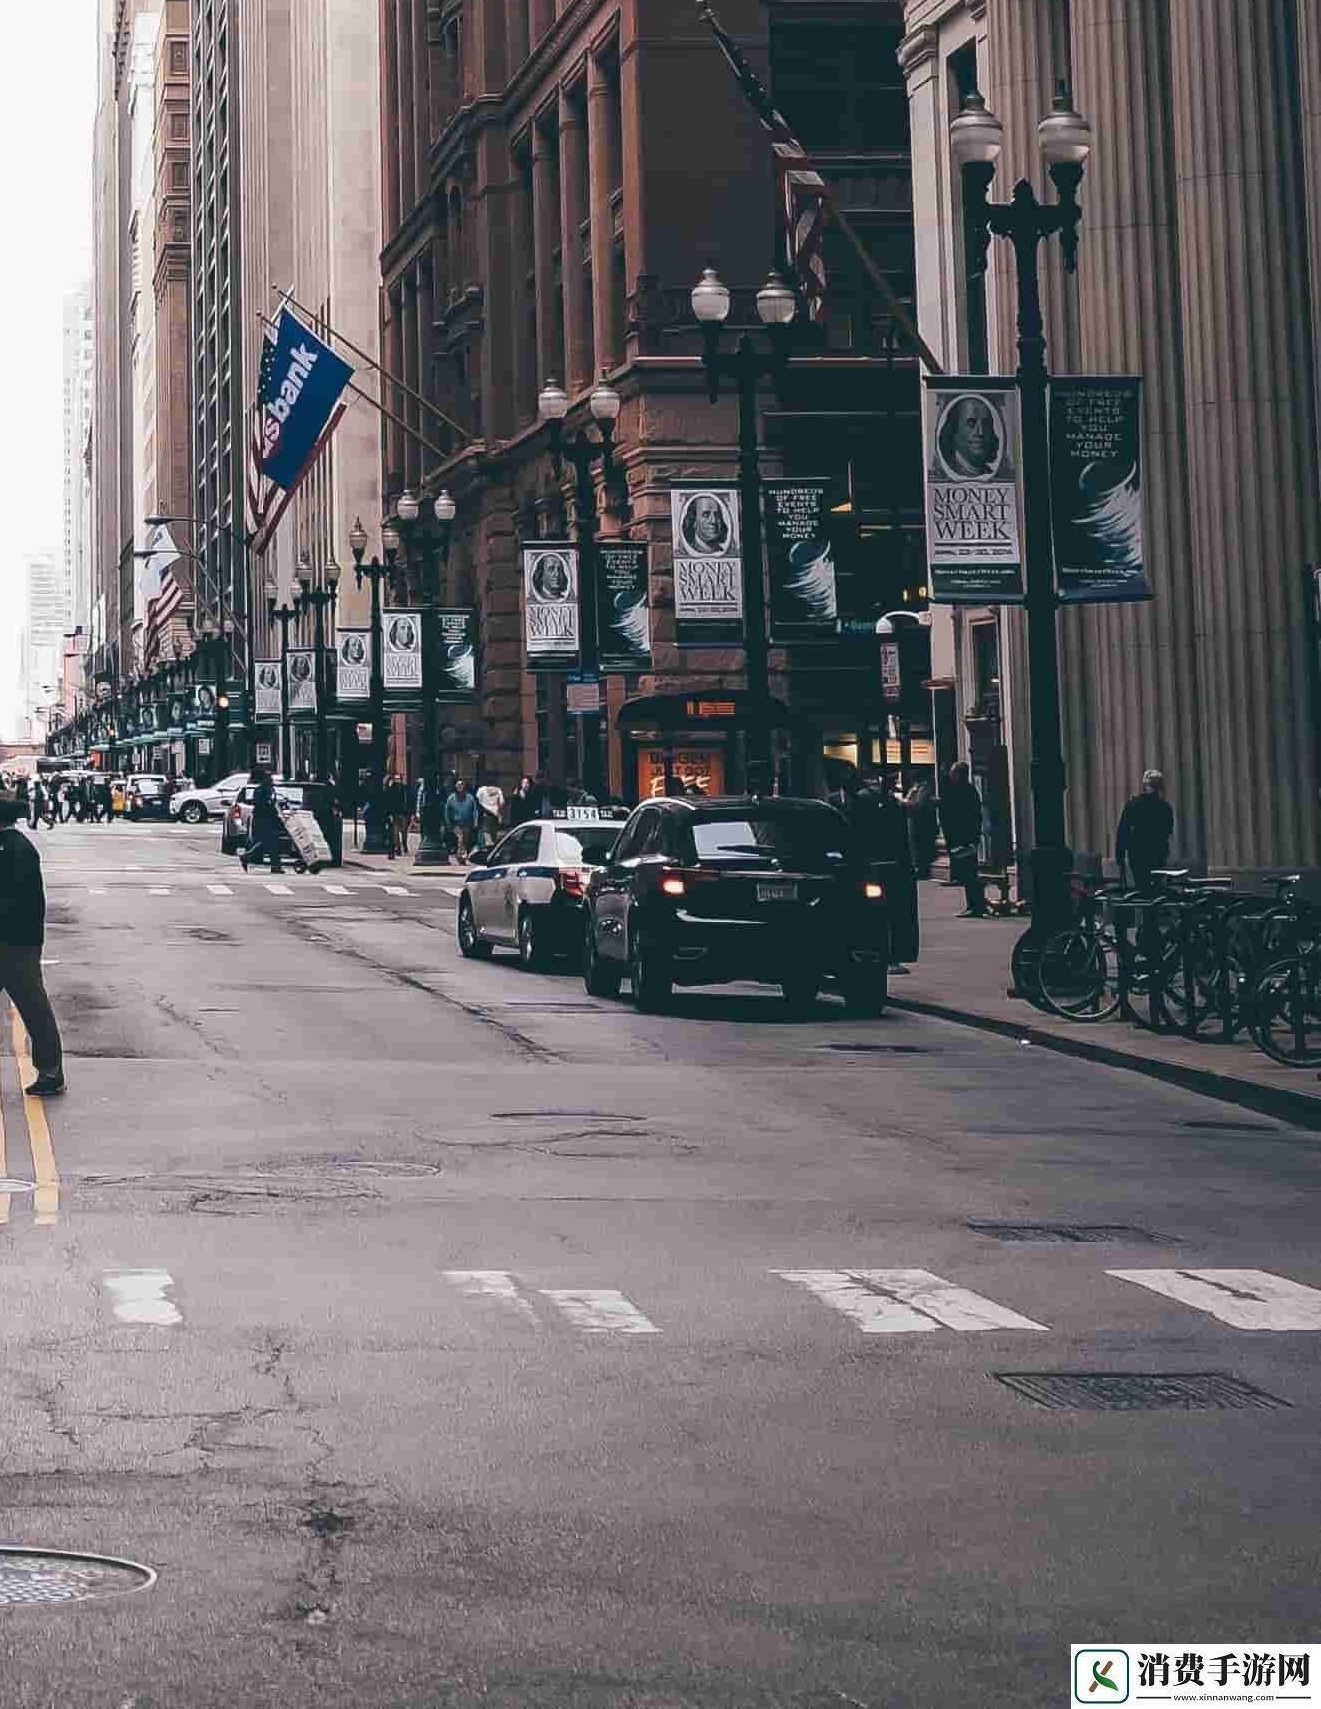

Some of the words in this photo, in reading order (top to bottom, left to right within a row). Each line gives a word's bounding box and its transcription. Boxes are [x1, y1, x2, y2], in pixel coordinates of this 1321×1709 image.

[933, 488, 1010, 504] MONEY
[933, 504, 1011, 521] SMART
[934, 521, 1012, 540] WEEK
[679, 561, 737, 572] MONEY
[679, 572, 737, 587] SMART
[679, 586, 737, 601] WEEK
